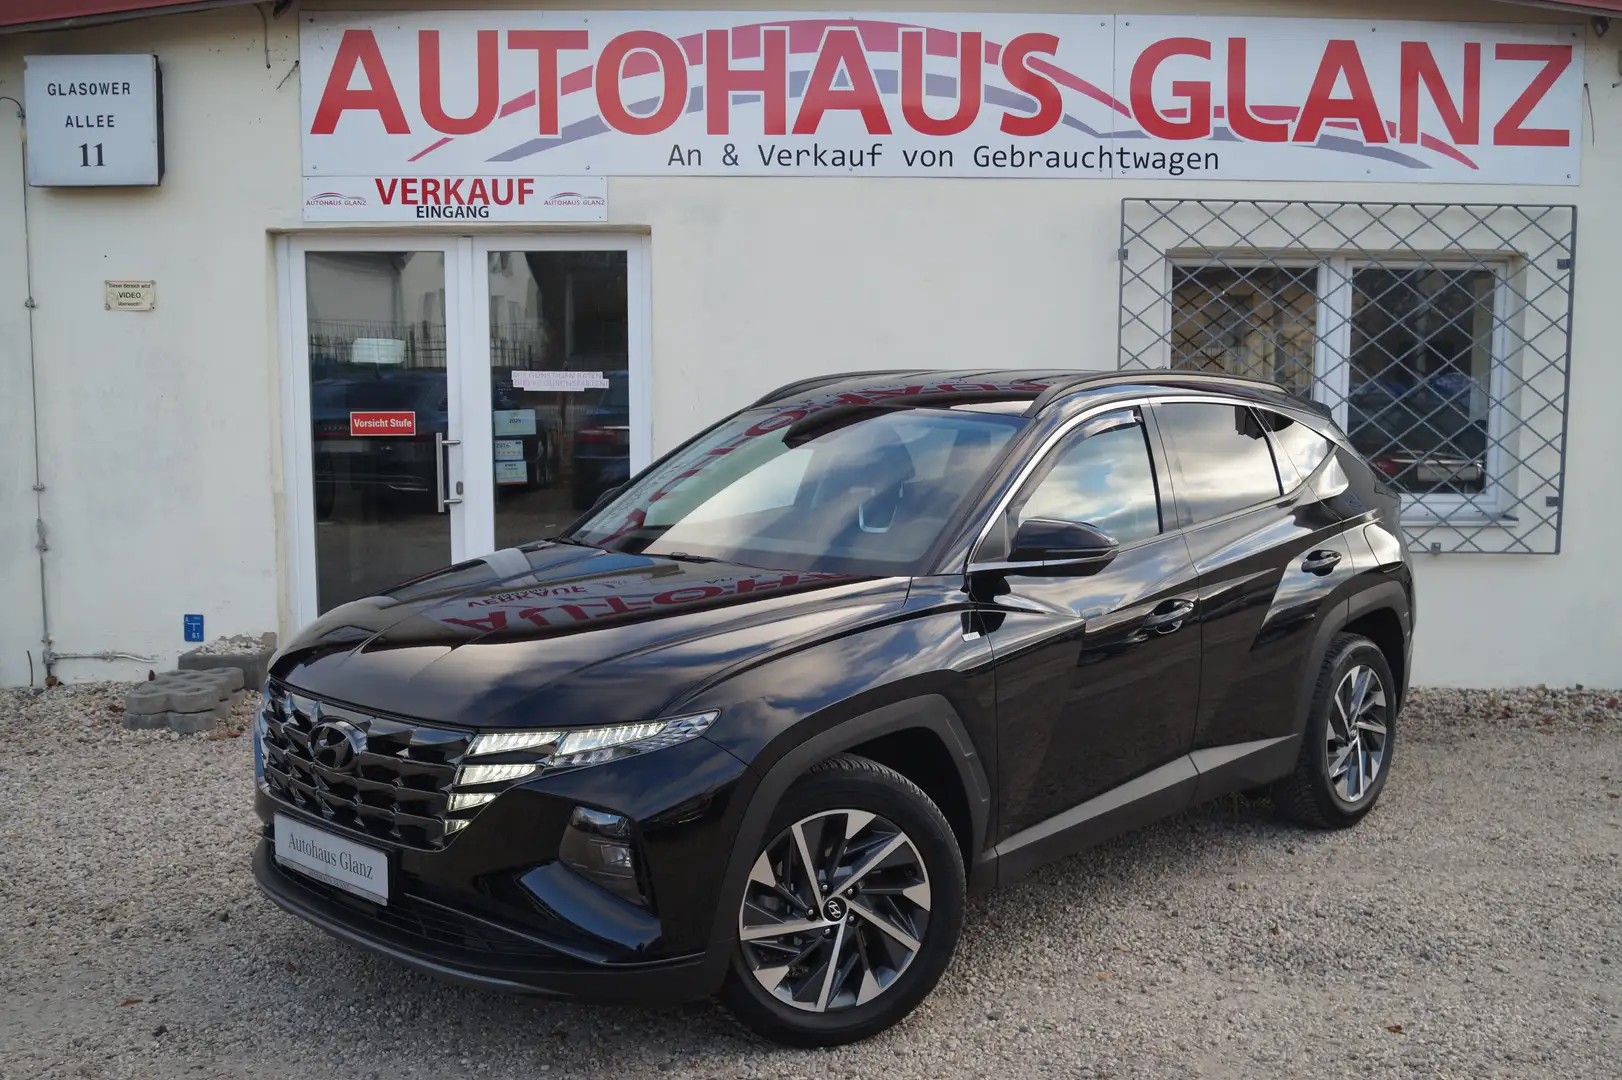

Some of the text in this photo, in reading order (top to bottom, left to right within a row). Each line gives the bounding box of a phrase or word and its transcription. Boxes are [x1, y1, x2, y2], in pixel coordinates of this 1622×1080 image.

[47, 82, 131, 96] GLASOWER
[310, 29, 1573, 147] AUTOHAUS GLANZ
[65, 115, 115, 128] ALLEE
[78, 142, 106, 168] 11
[668, 143, 1220, 176] An & Verkauf von Gebrauchtwagen
[375, 178, 534, 206] VERKAUF
[416, 205, 490, 219] EINGANG
[354, 418, 388, 428] Vorsicht
[390, 418, 412, 428] Stufe
[289, 833, 337, 865] Autohaus
[339, 851, 373, 880] Glanz
